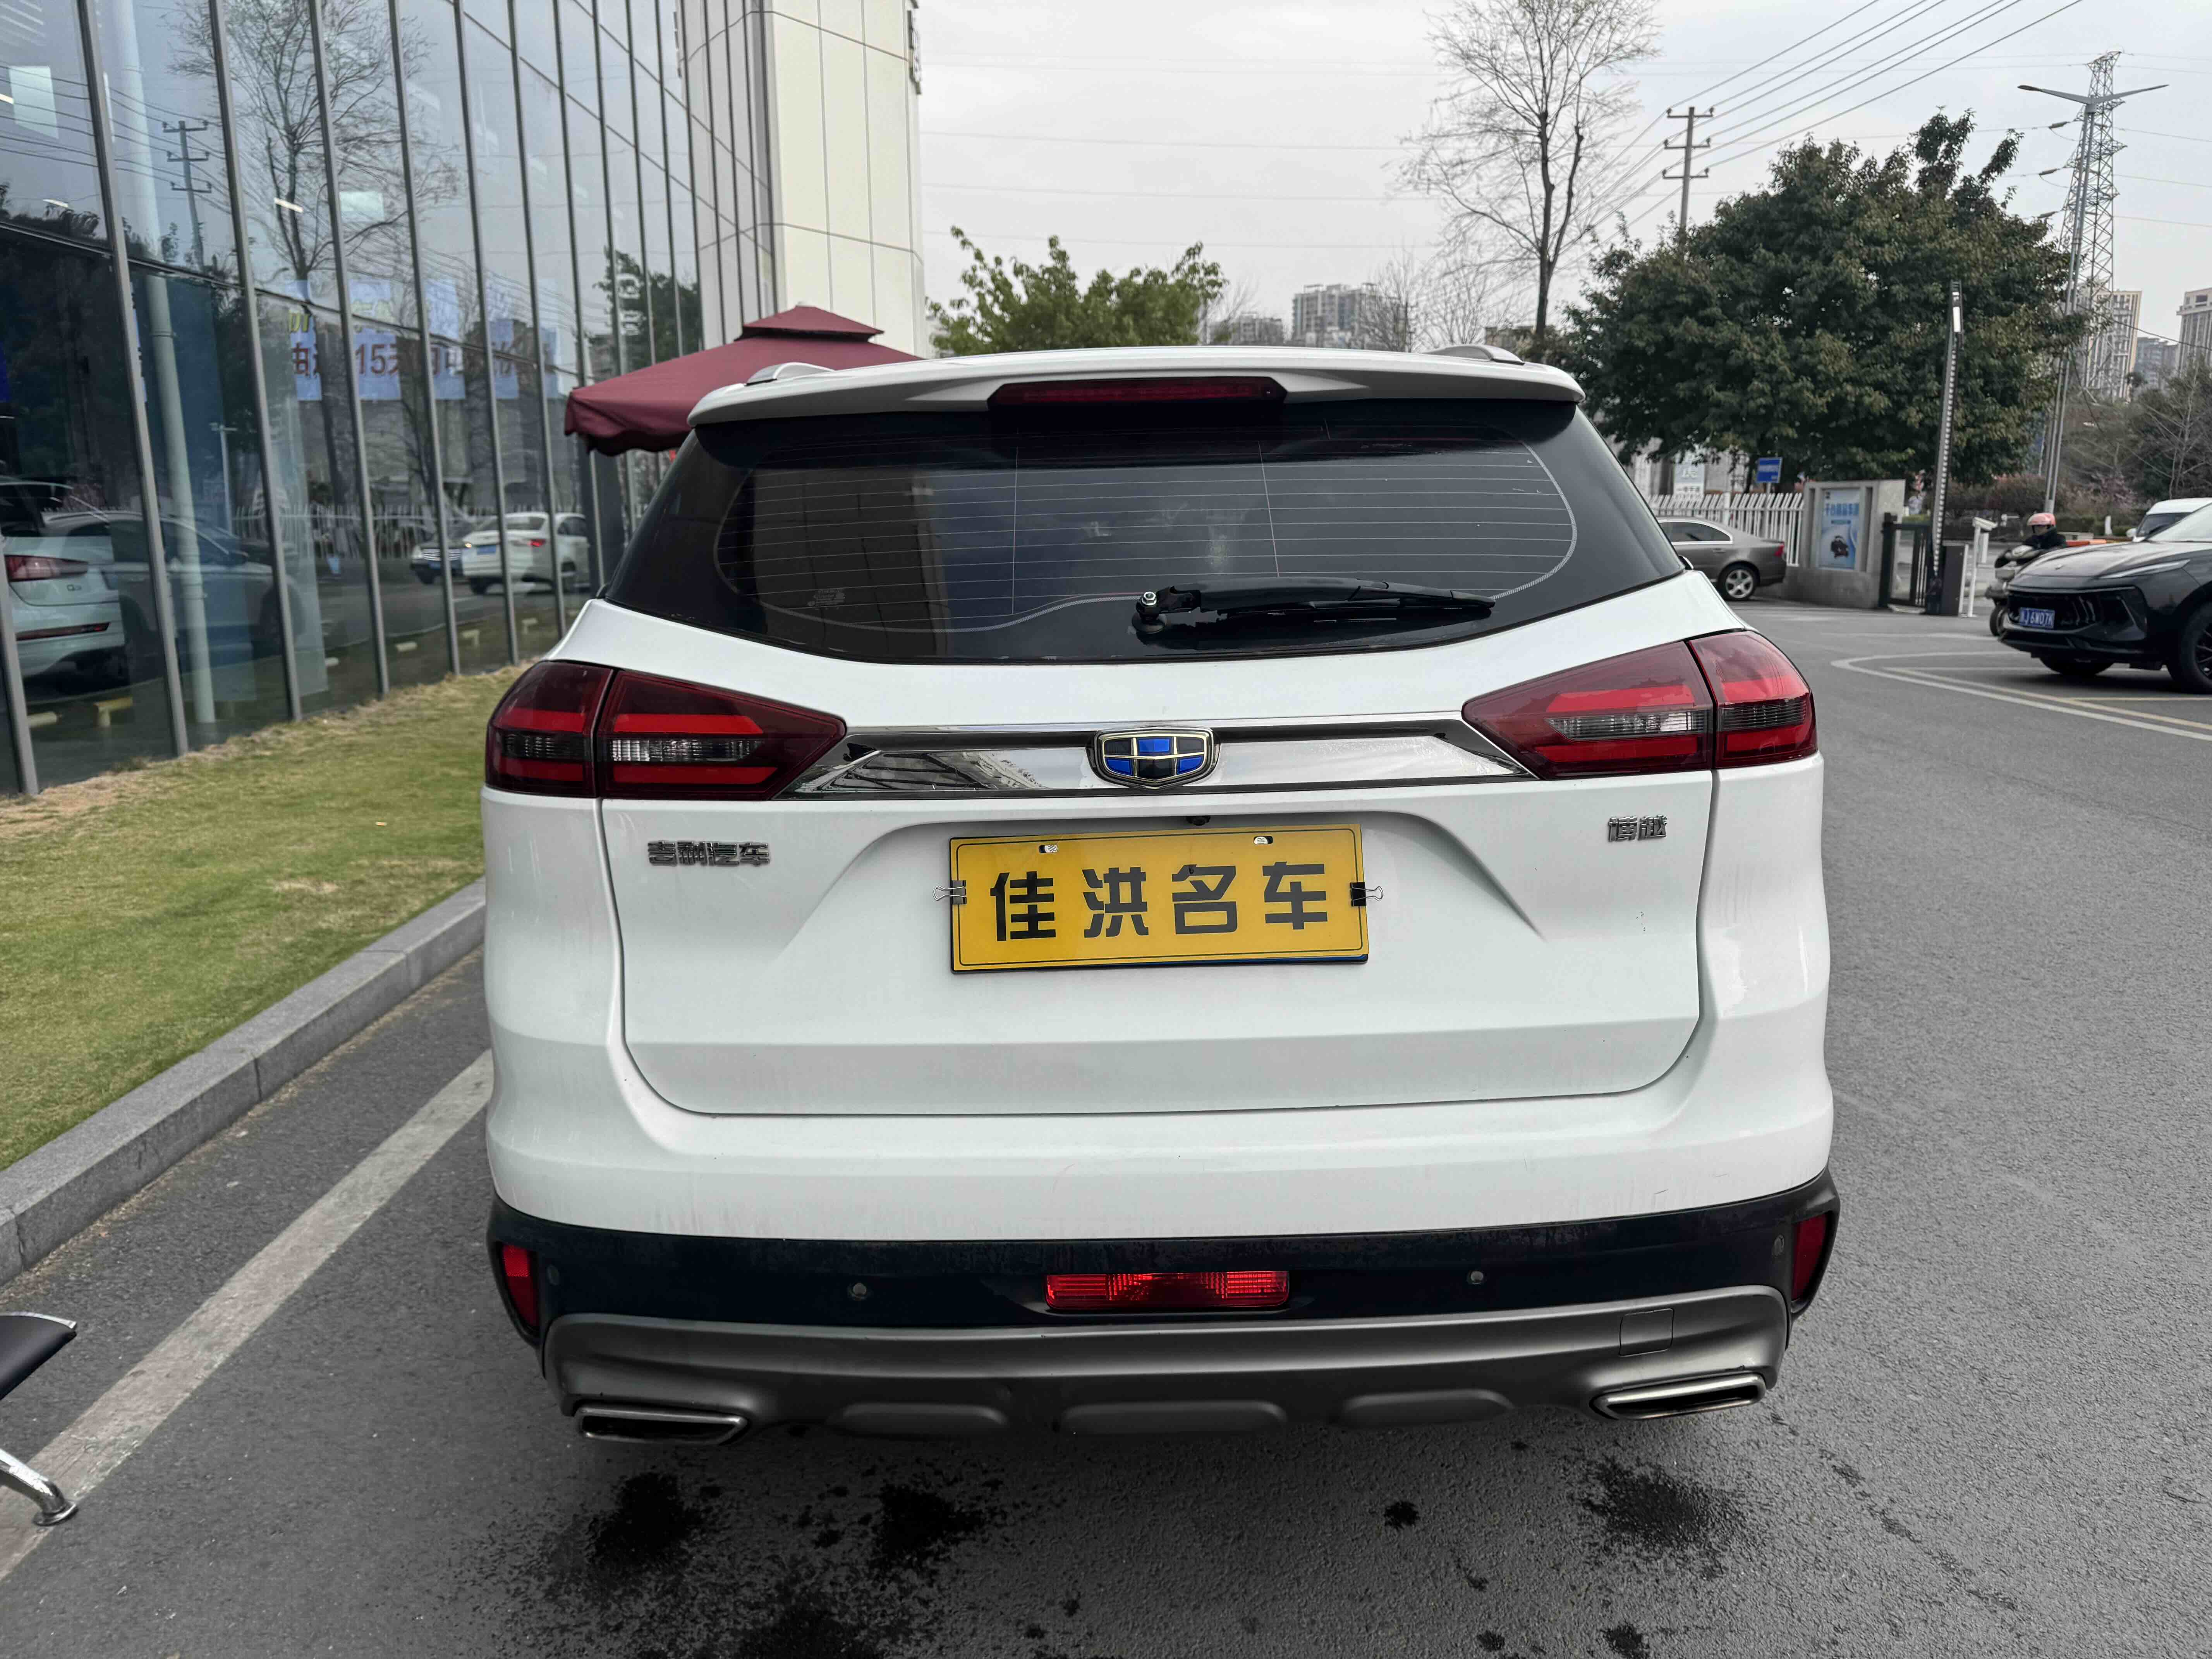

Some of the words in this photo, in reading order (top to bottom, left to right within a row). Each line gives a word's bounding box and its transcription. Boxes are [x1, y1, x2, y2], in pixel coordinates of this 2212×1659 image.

[1608, 815, 1668, 842] 博越
[647, 840, 770, 866] 吉利汽车
[990, 861, 1328, 941] 佳洪名车
